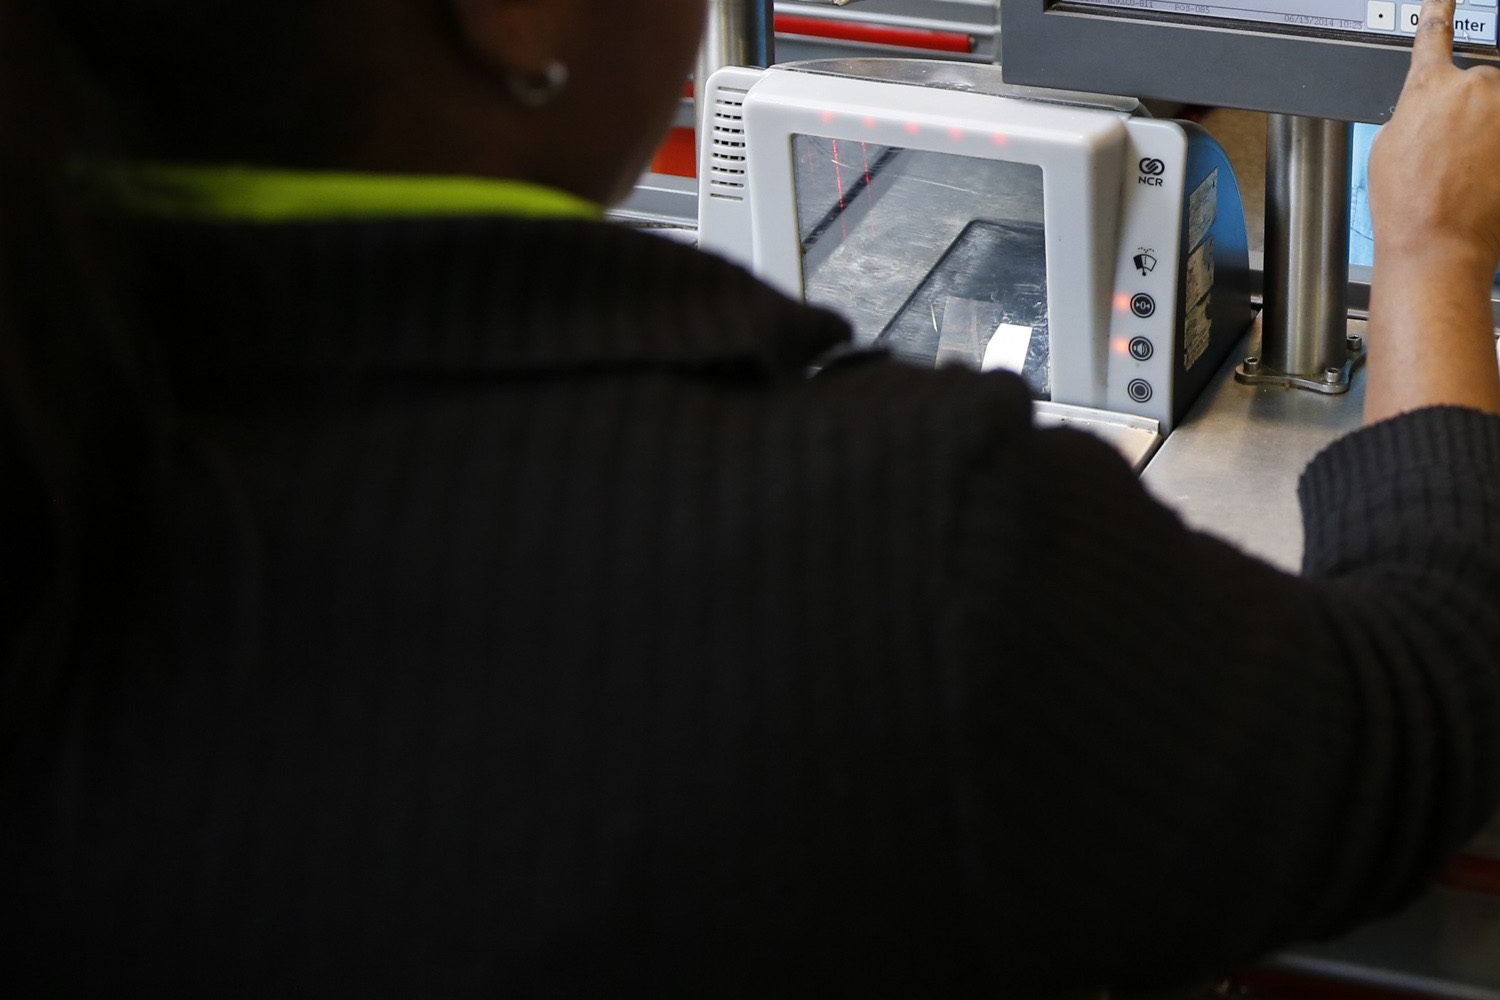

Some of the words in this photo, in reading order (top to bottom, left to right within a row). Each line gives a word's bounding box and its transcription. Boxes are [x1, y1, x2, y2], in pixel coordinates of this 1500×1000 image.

[1410, 13, 1419, 26] 0
[1455, 18, 1486, 33] nter
[1138, 176, 1163, 187] NCR
